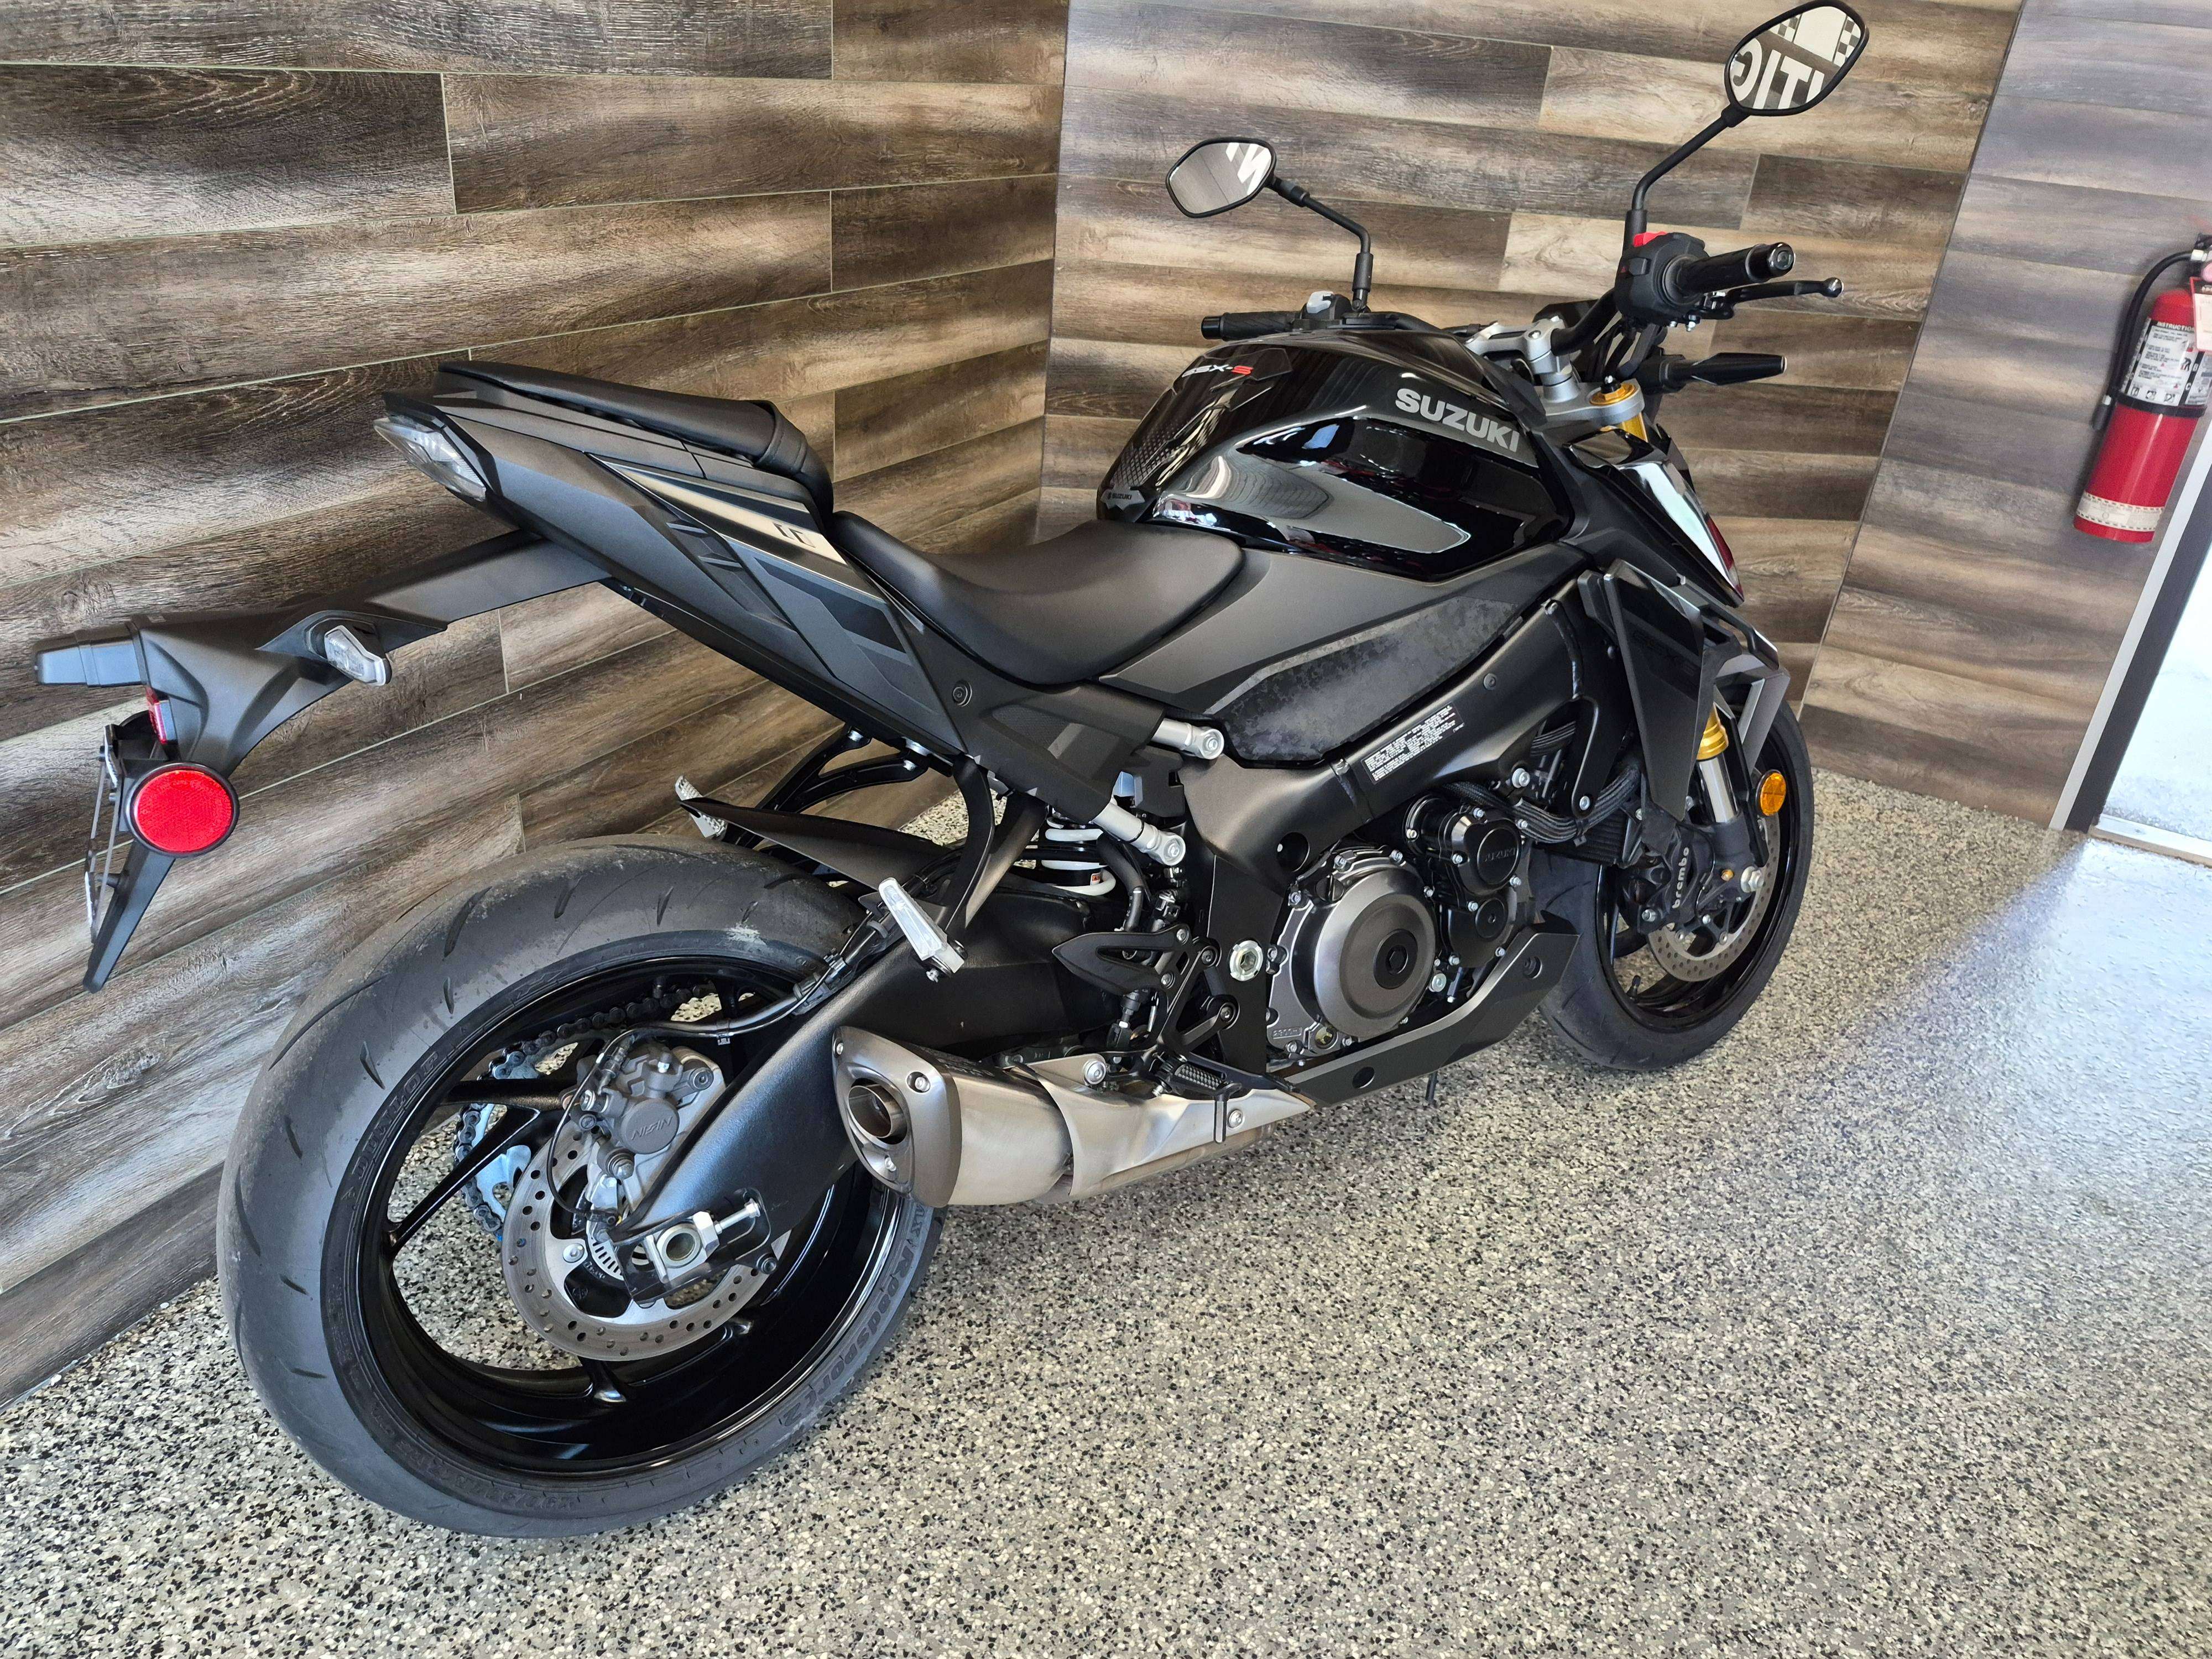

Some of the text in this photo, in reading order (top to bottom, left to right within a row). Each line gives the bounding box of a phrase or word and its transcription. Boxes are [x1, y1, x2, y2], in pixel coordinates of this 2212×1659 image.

[1395, 388, 1520, 452] SUZUKI
[1672, 847, 1689, 909] brembo
[352, 1051, 440, 1179] DUNLOP
